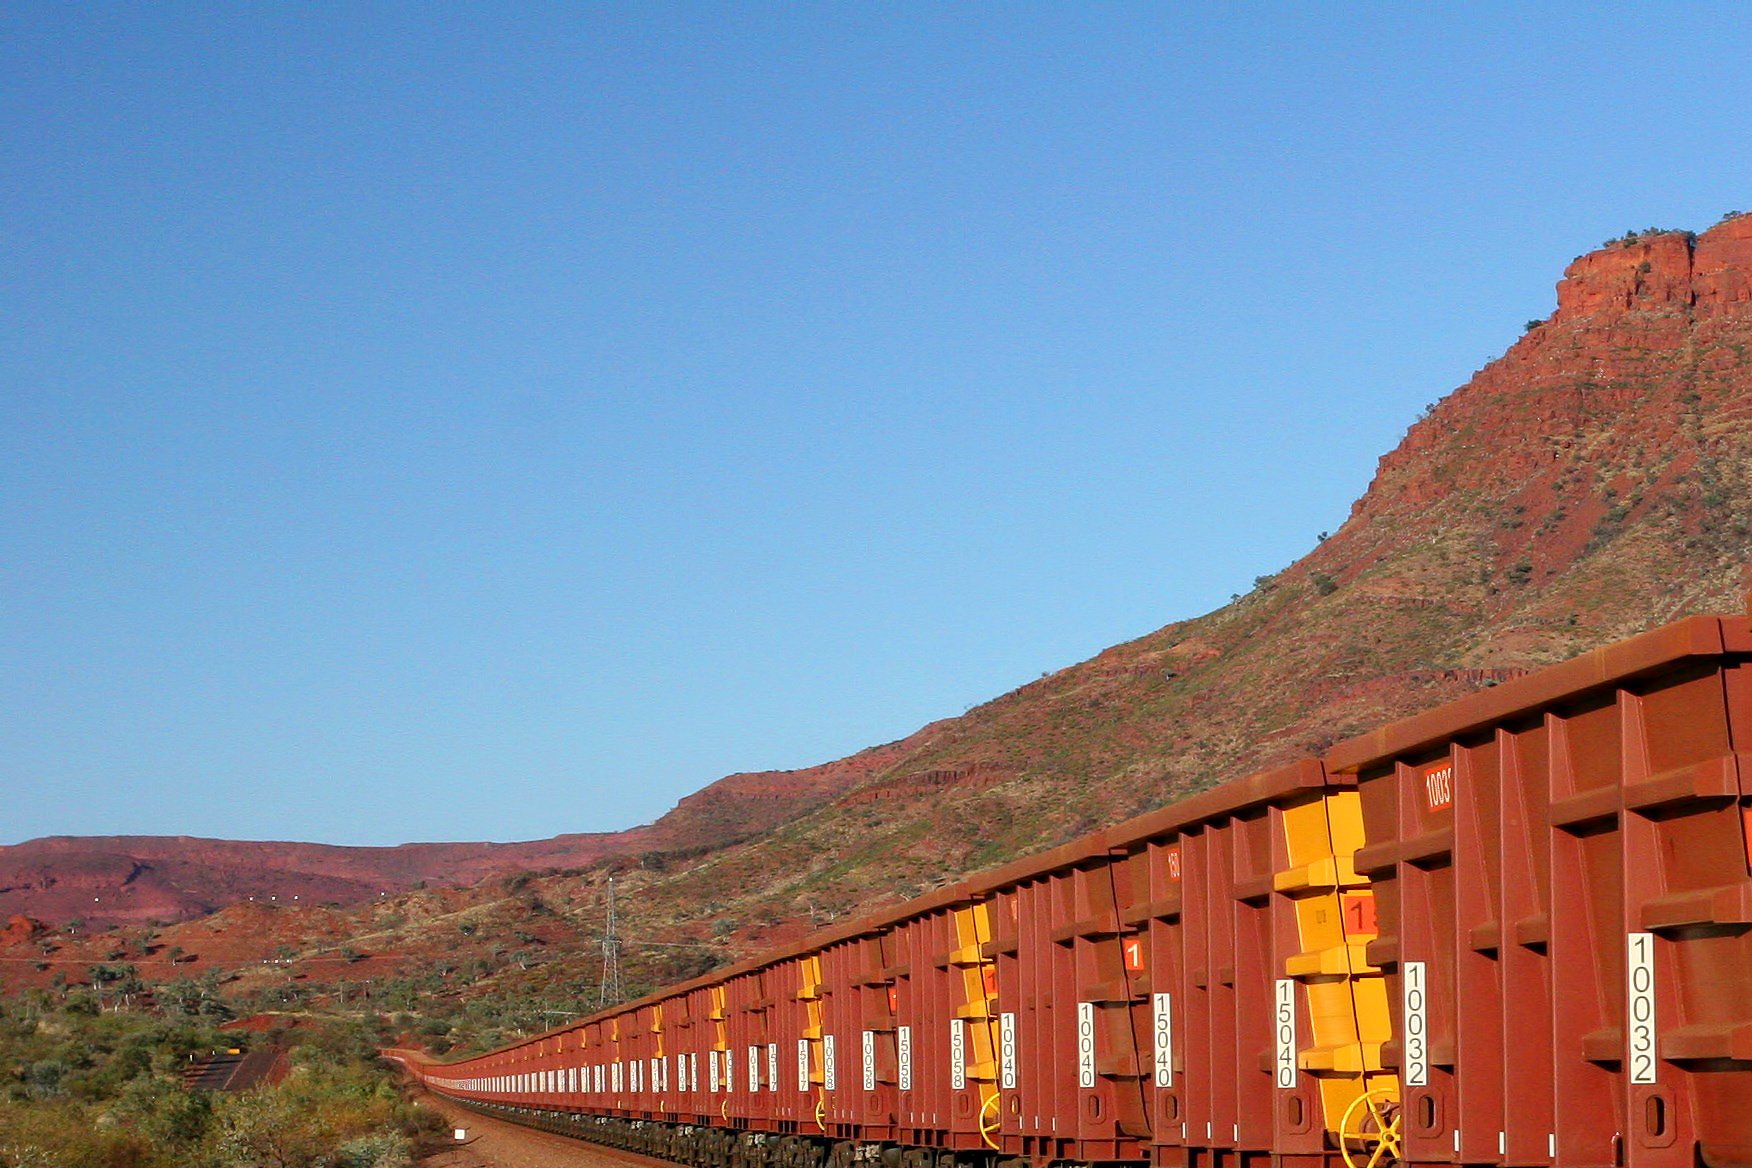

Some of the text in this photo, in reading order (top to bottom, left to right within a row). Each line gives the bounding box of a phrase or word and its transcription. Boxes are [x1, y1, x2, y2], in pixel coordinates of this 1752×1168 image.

[1127, 943, 1139, 967] 1
[1003, 1014, 1014, 1087] 10040
[1081, 1004, 1092, 1086] 10040
[1156, 994, 1171, 1087] 15040
[1278, 982, 1293, 1087] 15040
[1408, 965, 1424, 1084] 10032
[1633, 936, 1652, 1082] 10032
[952, 1021, 963, 1088] 15058
